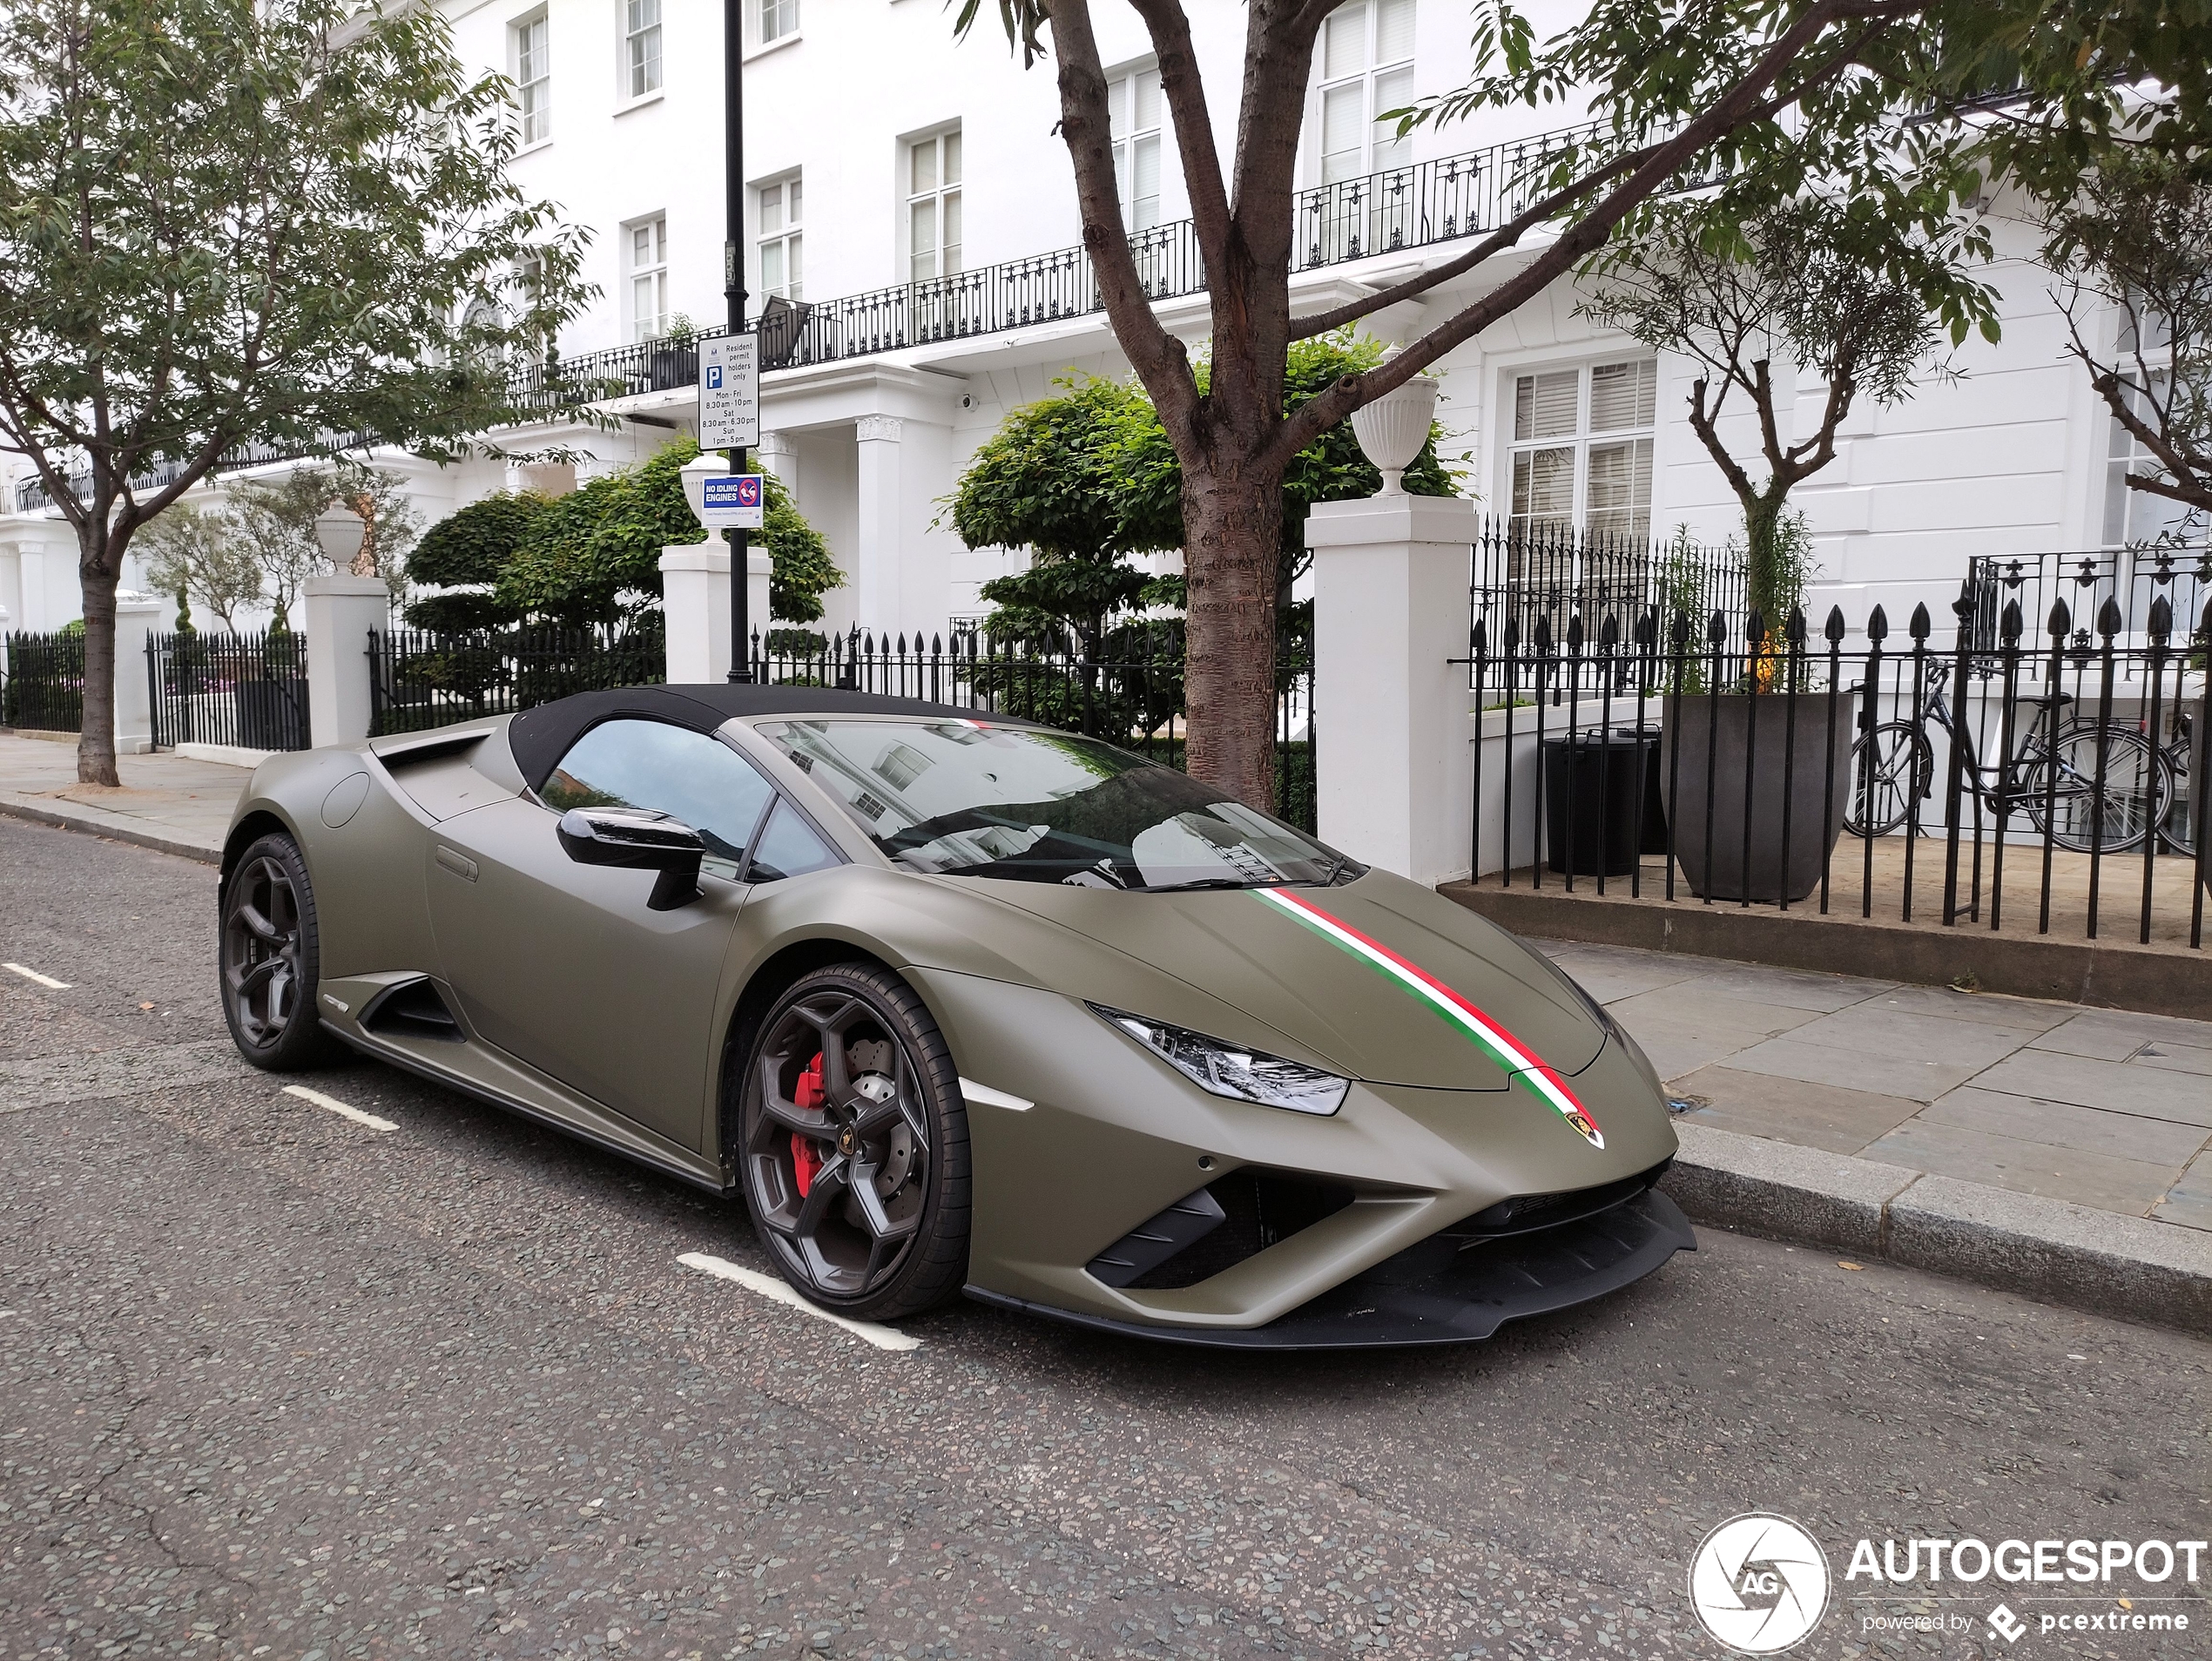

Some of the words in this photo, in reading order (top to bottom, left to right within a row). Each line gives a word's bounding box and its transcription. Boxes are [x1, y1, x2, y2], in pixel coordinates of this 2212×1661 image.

[725, 342, 752, 352] Resident
[729, 352, 750, 362] permit
[709, 368, 720, 388] P
[717, 484, 738, 493] IDLING
[705, 493, 737, 502] ENGINES
